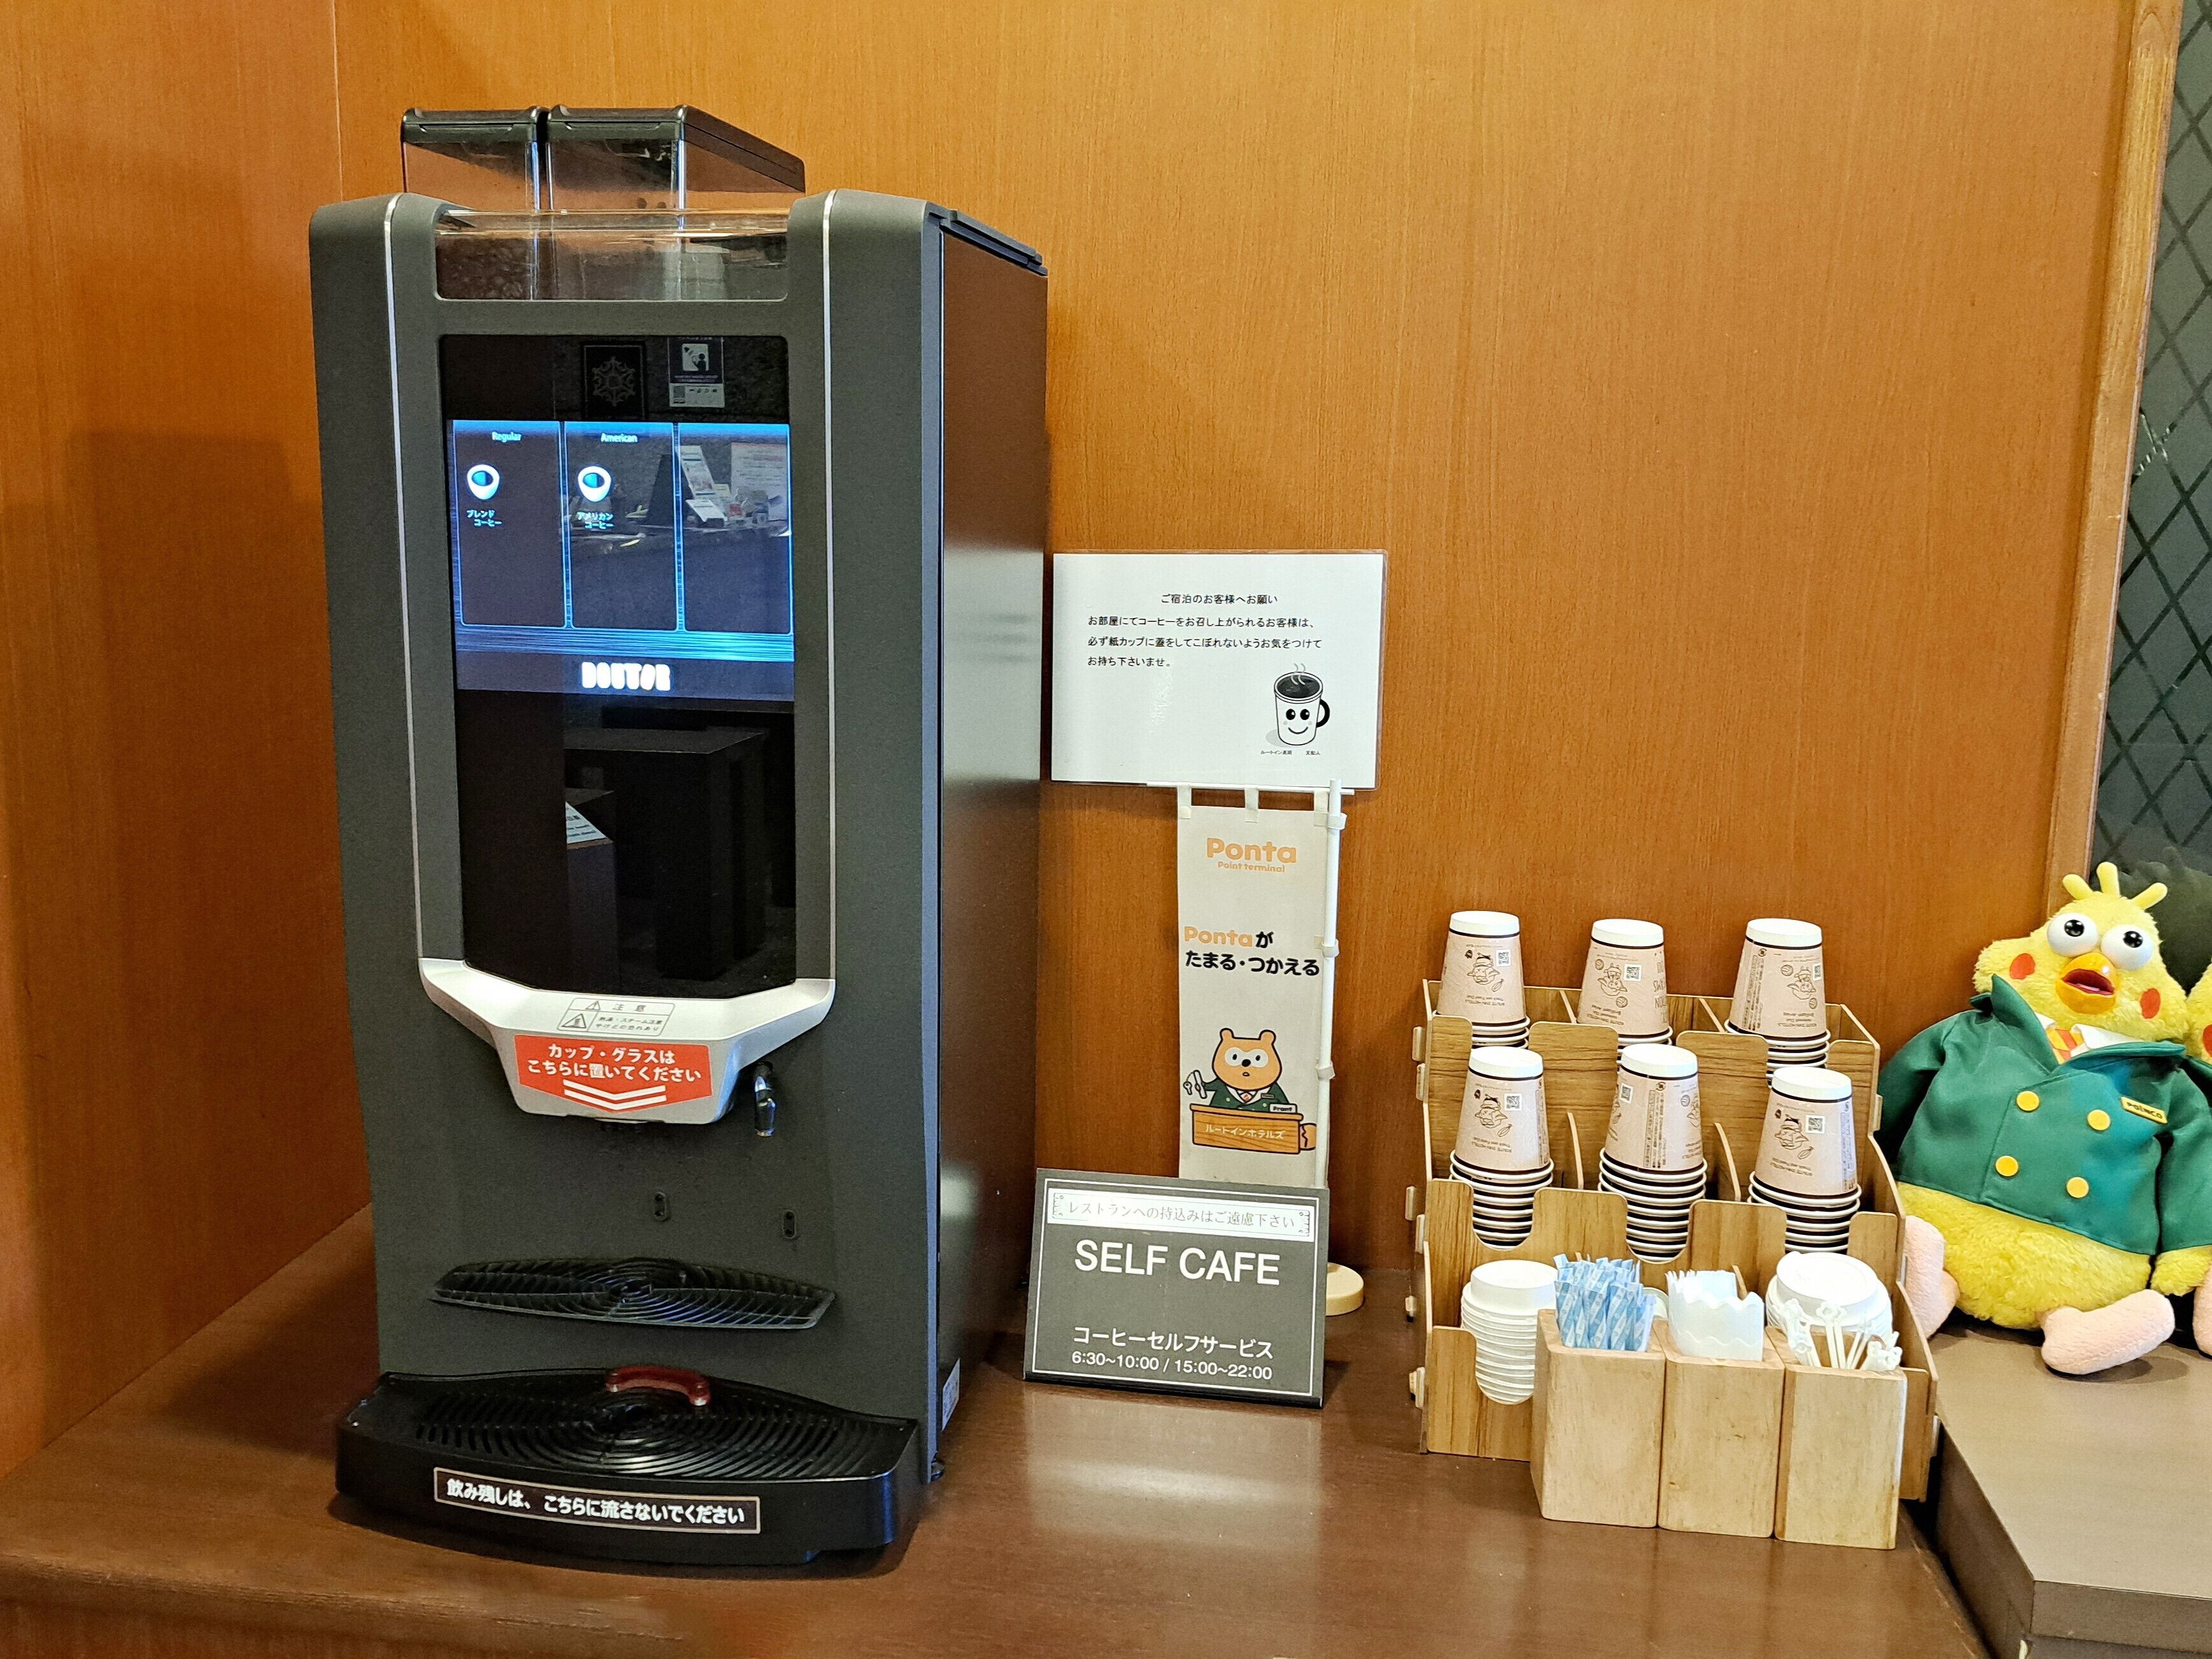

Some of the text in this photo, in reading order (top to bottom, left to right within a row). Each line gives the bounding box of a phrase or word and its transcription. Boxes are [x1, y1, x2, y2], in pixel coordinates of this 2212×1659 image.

[491, 431, 522, 443] Regular
[600, 433, 638, 443] American
[467, 509, 496, 518] ブレンド
[577, 512, 614, 521] アメリカン
[585, 521, 614, 529] コーヒー
[1161, 594, 1278, 605] ご宿泊のお客様へお願い
[1088, 615, 1314, 628] お部屋にてコーヒーをお召し上がられるお客様は、
[1088, 636, 1323, 649] 必ず紙カップに蓋をしてこぼれないようお気をつけて
[1088, 656, 1171, 668] お持ち下さいませ。
[1207, 837, 1296, 864] Ponta
[1217, 861, 1285, 873] Point terminal
[1184, 925, 1274, 949] Pontaが
[1185, 949, 1320, 977] たまる・つかえる
[548, 1043, 676, 1065] カップ・グラスは
[528, 1060, 702, 1083] こちらに置いてください
[1205, 1123, 1286, 1140] ルートインホテルズ
[1069, 1201, 1295, 1228] レストランへの持込みはご遠慮下さい
[1074, 1239, 1281, 1286] SELF CAFE
[1073, 1326, 1274, 1360] コーヒーセルフサービス
